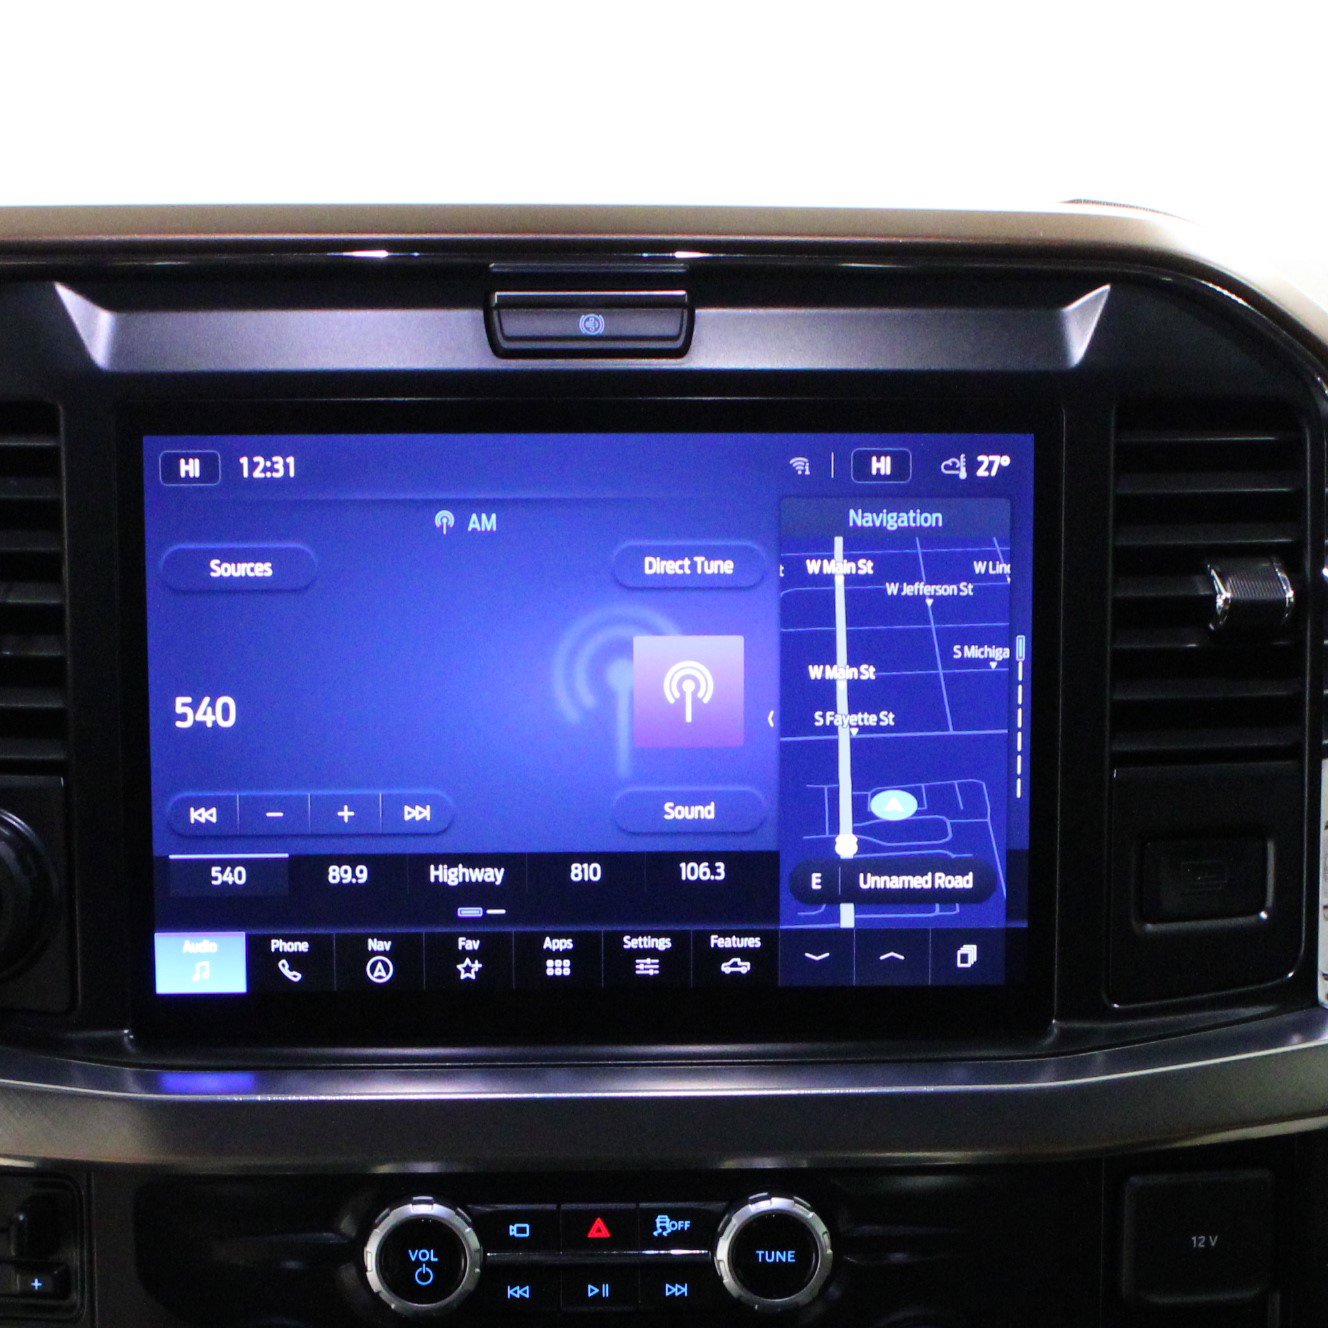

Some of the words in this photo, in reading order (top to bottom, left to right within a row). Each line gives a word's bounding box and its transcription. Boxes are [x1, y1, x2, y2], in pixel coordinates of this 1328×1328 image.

[179, 457, 200, 478] HI
[239, 456, 296, 478] 12:31
[871, 455, 891, 475] HI
[976, 454, 1011, 477] 27°
[468, 513, 497, 532] AM
[849, 508, 943, 530] Navigation
[209, 559, 273, 578] Sources
[644, 556, 691, 575] Direct
[693, 556, 735, 575] Tune
[806, 559, 823, 575] W
[823, 558, 856, 575] Main
[857, 558, 874, 574] St
[973, 560, 987, 575] W
[885, 583, 900, 596] W
[900, 582, 958, 596] Jefferson
[960, 582, 973, 595] St
[953, 645, 962, 658] S
[808, 665, 825, 680] W
[826, 664, 858, 680] Main
[859, 664, 876, 680] St
[174, 696, 237, 728] 540
[814, 711, 824, 726] S
[826, 711, 877, 729] Fayette
[879, 711, 895, 726] St
[663, 801, 715, 820] Sound
[210, 866, 247, 885] 540
[327, 865, 368, 884] 89.9
[429, 863, 505, 886] Highway
[570, 863, 602, 882] 810
[679, 862, 726, 881] 106.3
[859, 872, 932, 889] Unnamed
[934, 871, 973, 888] Road
[811, 873, 822, 889] E
[182, 939, 218, 953] Audio
[271, 939, 309, 952] Phone
[367, 938, 391, 951] Nav
[457, 937, 480, 950] Fav
[543, 937, 573, 952] Apps
[623, 935, 672, 951] Settings
[710, 934, 761, 949] Features
[669, 1220, 691, 1231] OFF
[1191, 1235, 1206, 1248] 12
[1208, 1235, 1219, 1248] V
[408, 1248, 438, 1263] VOL
[756, 1249, 796, 1263] TUNE
